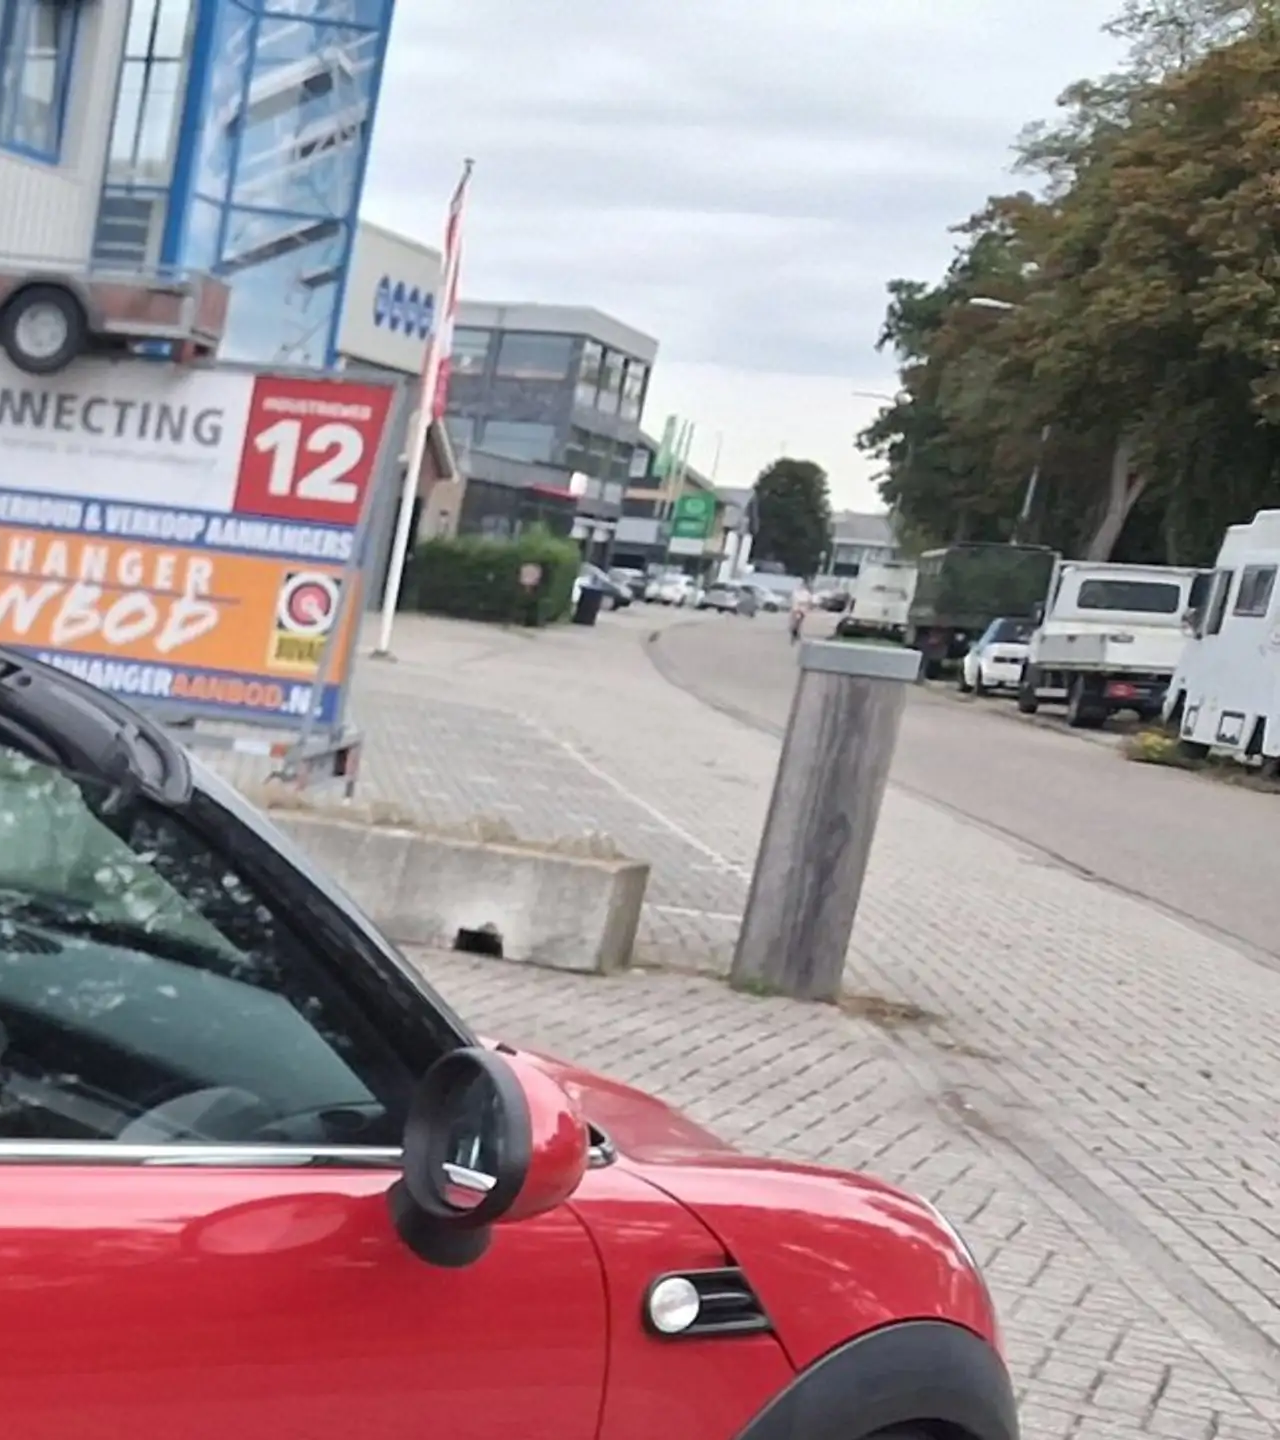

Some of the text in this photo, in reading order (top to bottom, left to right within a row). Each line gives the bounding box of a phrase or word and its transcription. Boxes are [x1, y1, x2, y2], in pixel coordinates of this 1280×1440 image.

[254, 418, 365, 503] 12
[83, 502, 102, 532] &
[104, 504, 206, 543] VERKOOP
[204, 516, 356, 560] AANHANGERS
